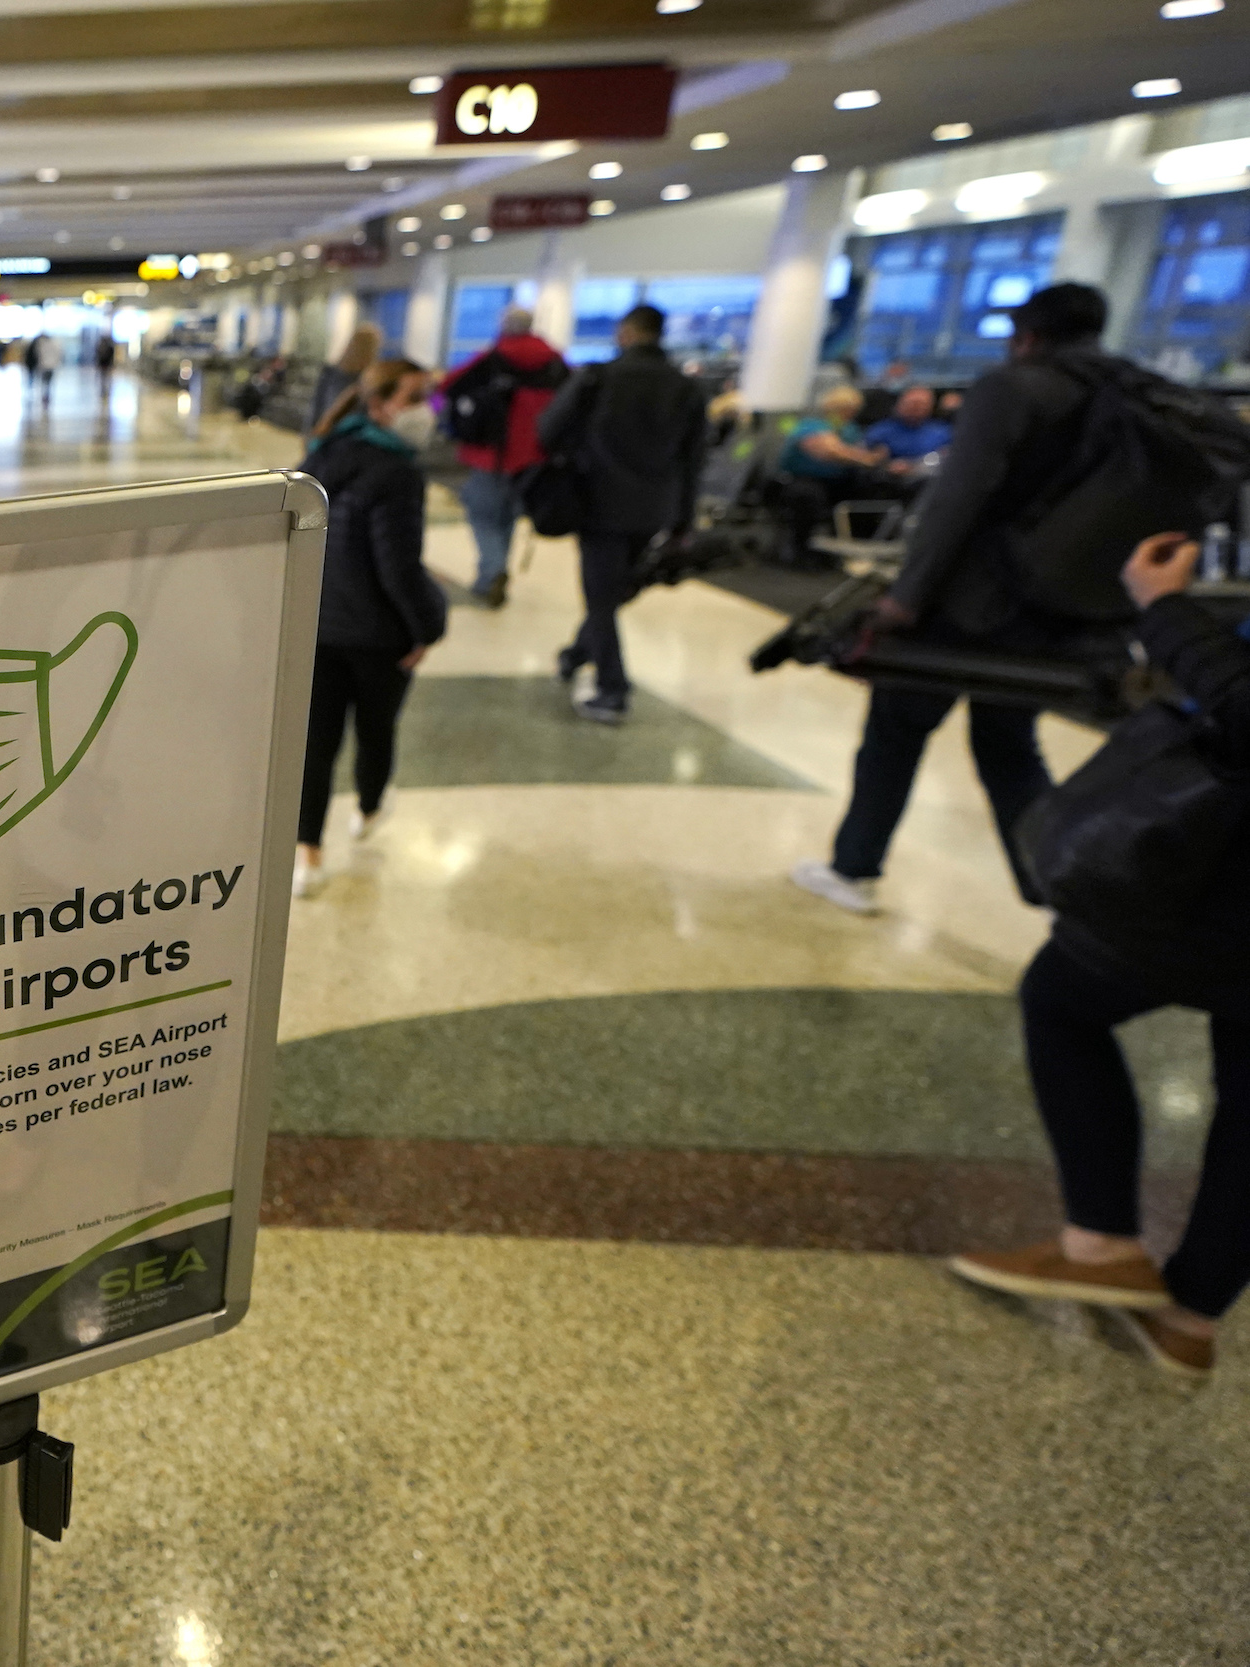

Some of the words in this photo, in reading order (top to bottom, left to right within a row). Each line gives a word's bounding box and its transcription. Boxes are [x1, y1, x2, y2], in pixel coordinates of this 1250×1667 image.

[455, 82, 538, 135] C10
[48, 1046, 90, 1071] and
[98, 1034, 146, 1058] SEA
[151, 1013, 227, 1047] Airport
[45, 1073, 96, 1097] over
[103, 1059, 153, 1087] your
[160, 1045, 212, 1068] nose
[26, 1107, 63, 1132] per
[69, 1082, 145, 1116] federal
[153, 1074, 193, 1095] law.
[19, 1229, 66, 1247] Measures
[76, 1219, 102, 1232] Mask
[104, 1201, 166, 1223] Requirements
[98, 1247, 208, 1300] SEA
